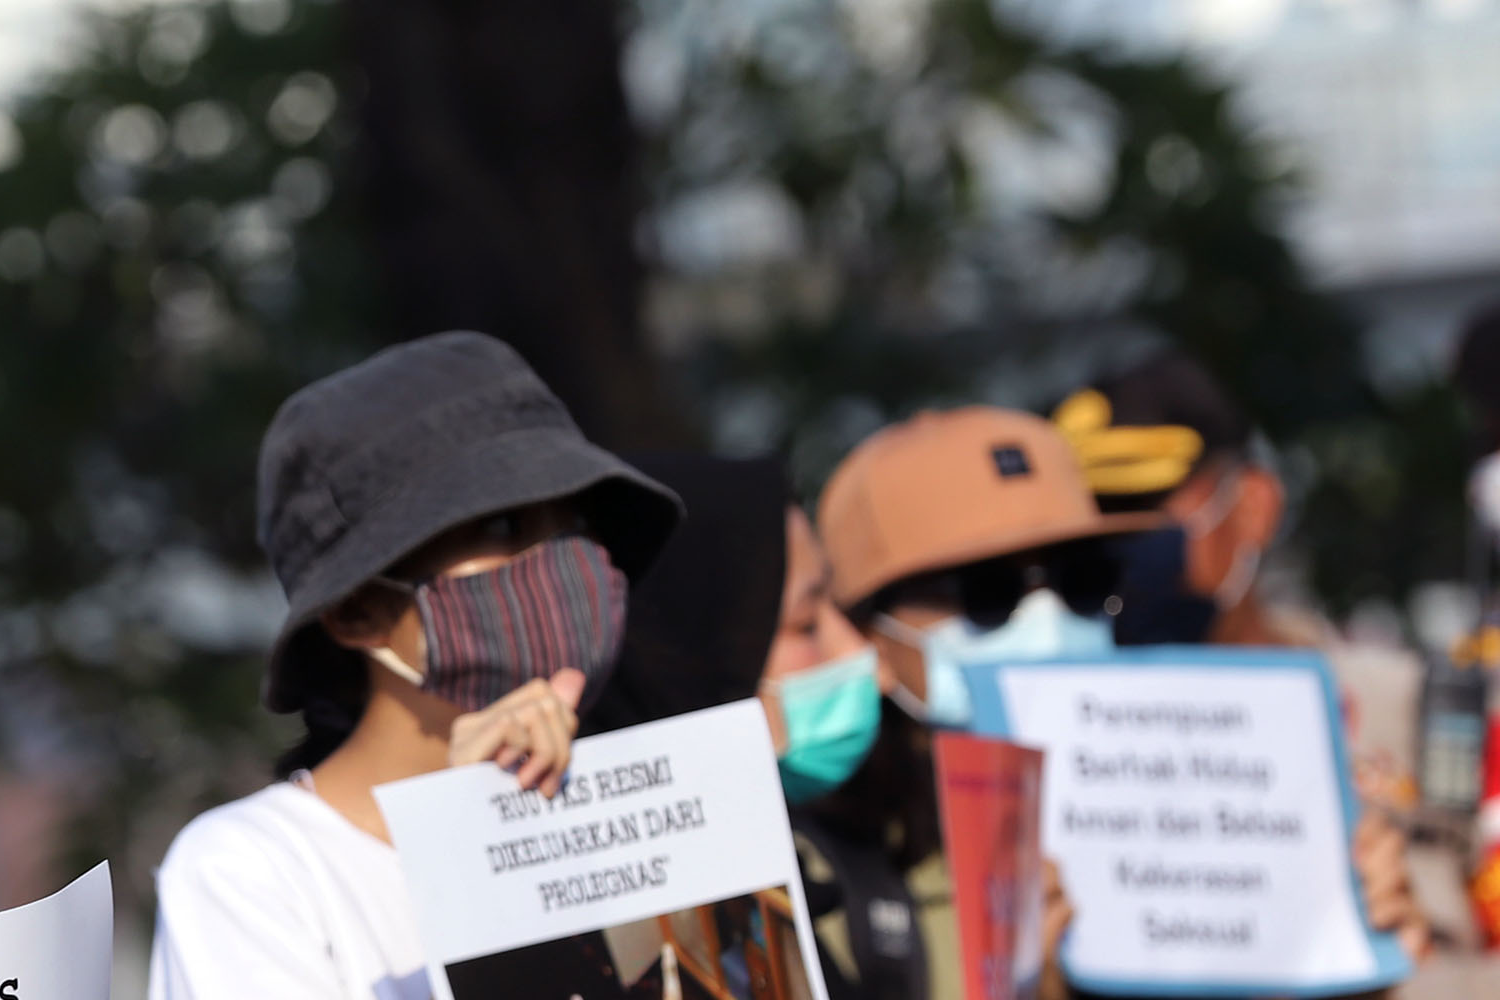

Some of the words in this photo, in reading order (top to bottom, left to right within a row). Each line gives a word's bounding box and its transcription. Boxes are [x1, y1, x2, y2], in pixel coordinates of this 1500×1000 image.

[596, 754, 674, 801] RESMI
[486, 812, 641, 874] DIKELUARKAN
[643, 796, 707, 839] DARI
